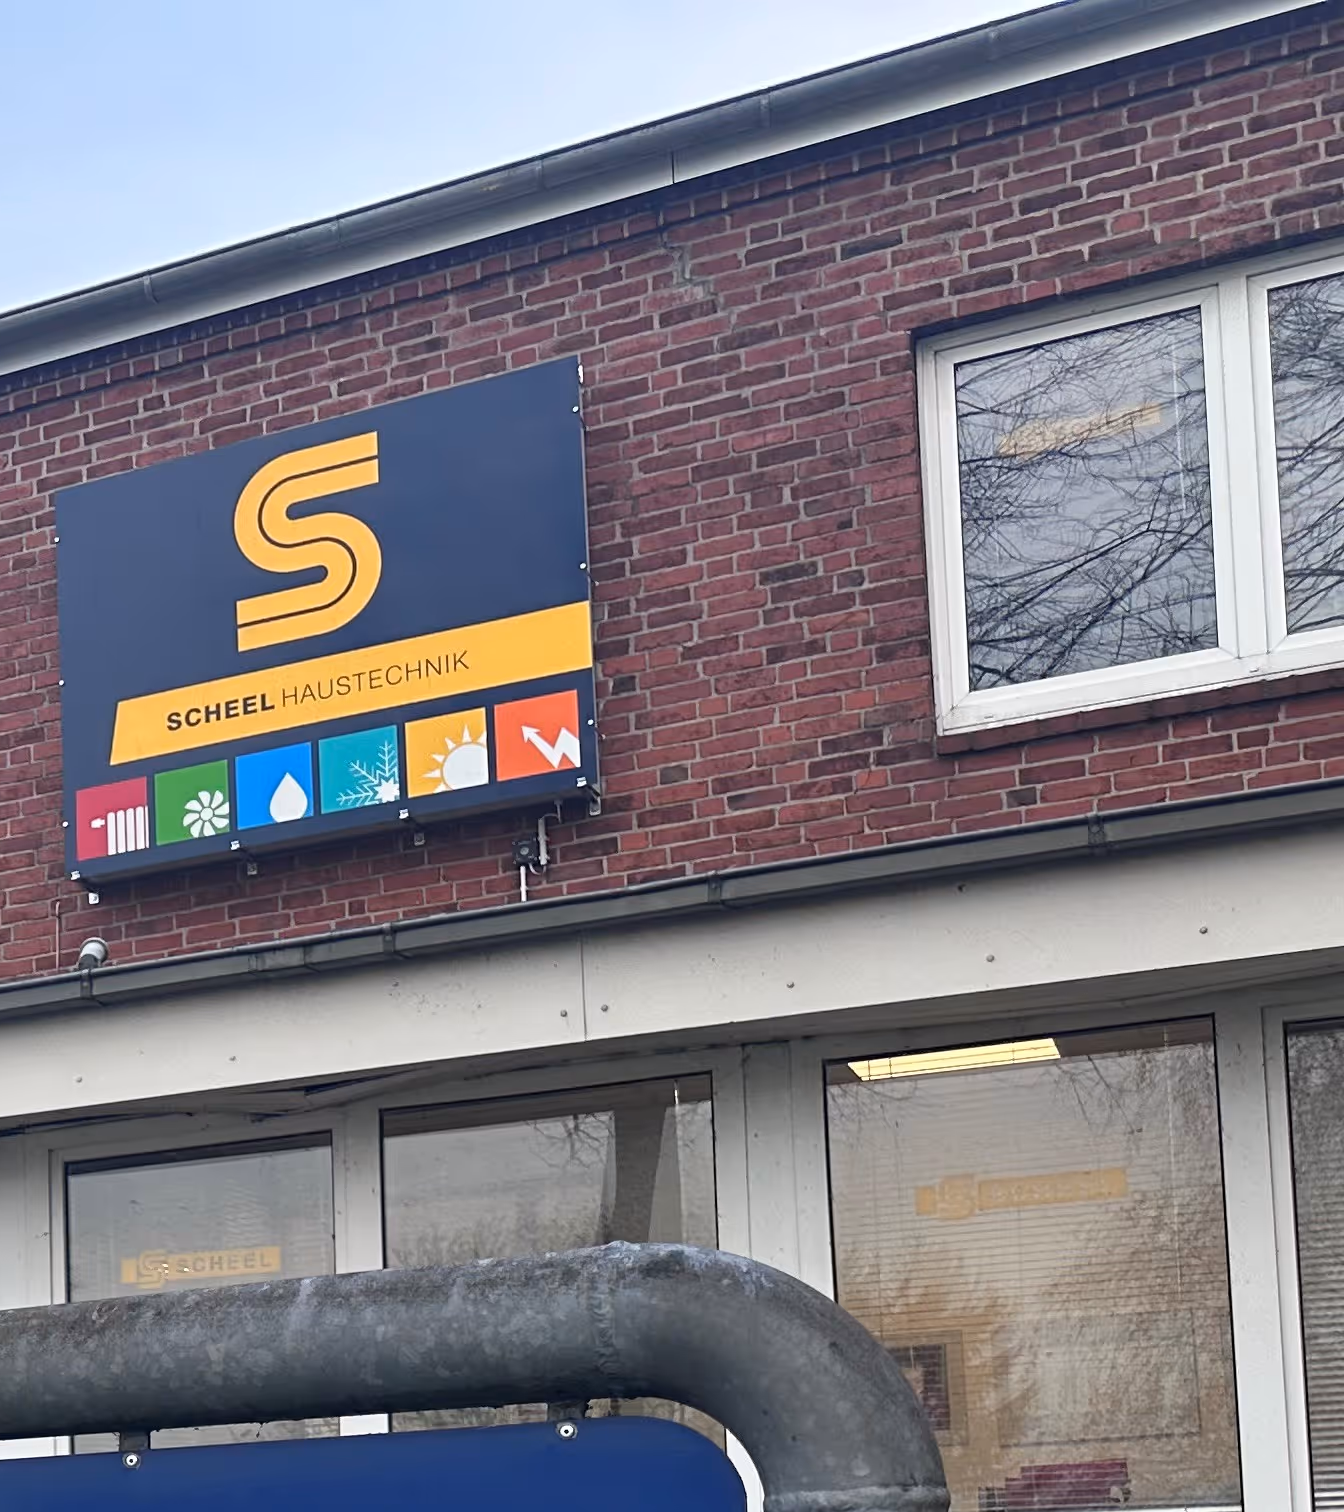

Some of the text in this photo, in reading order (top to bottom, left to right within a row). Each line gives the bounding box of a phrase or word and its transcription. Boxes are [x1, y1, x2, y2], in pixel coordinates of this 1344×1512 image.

[233, 431, 382, 652] S
[166, 650, 469, 731] SCHEEL HAUSTECHNIK
[176, 1252, 272, 1274] SCHEEL
